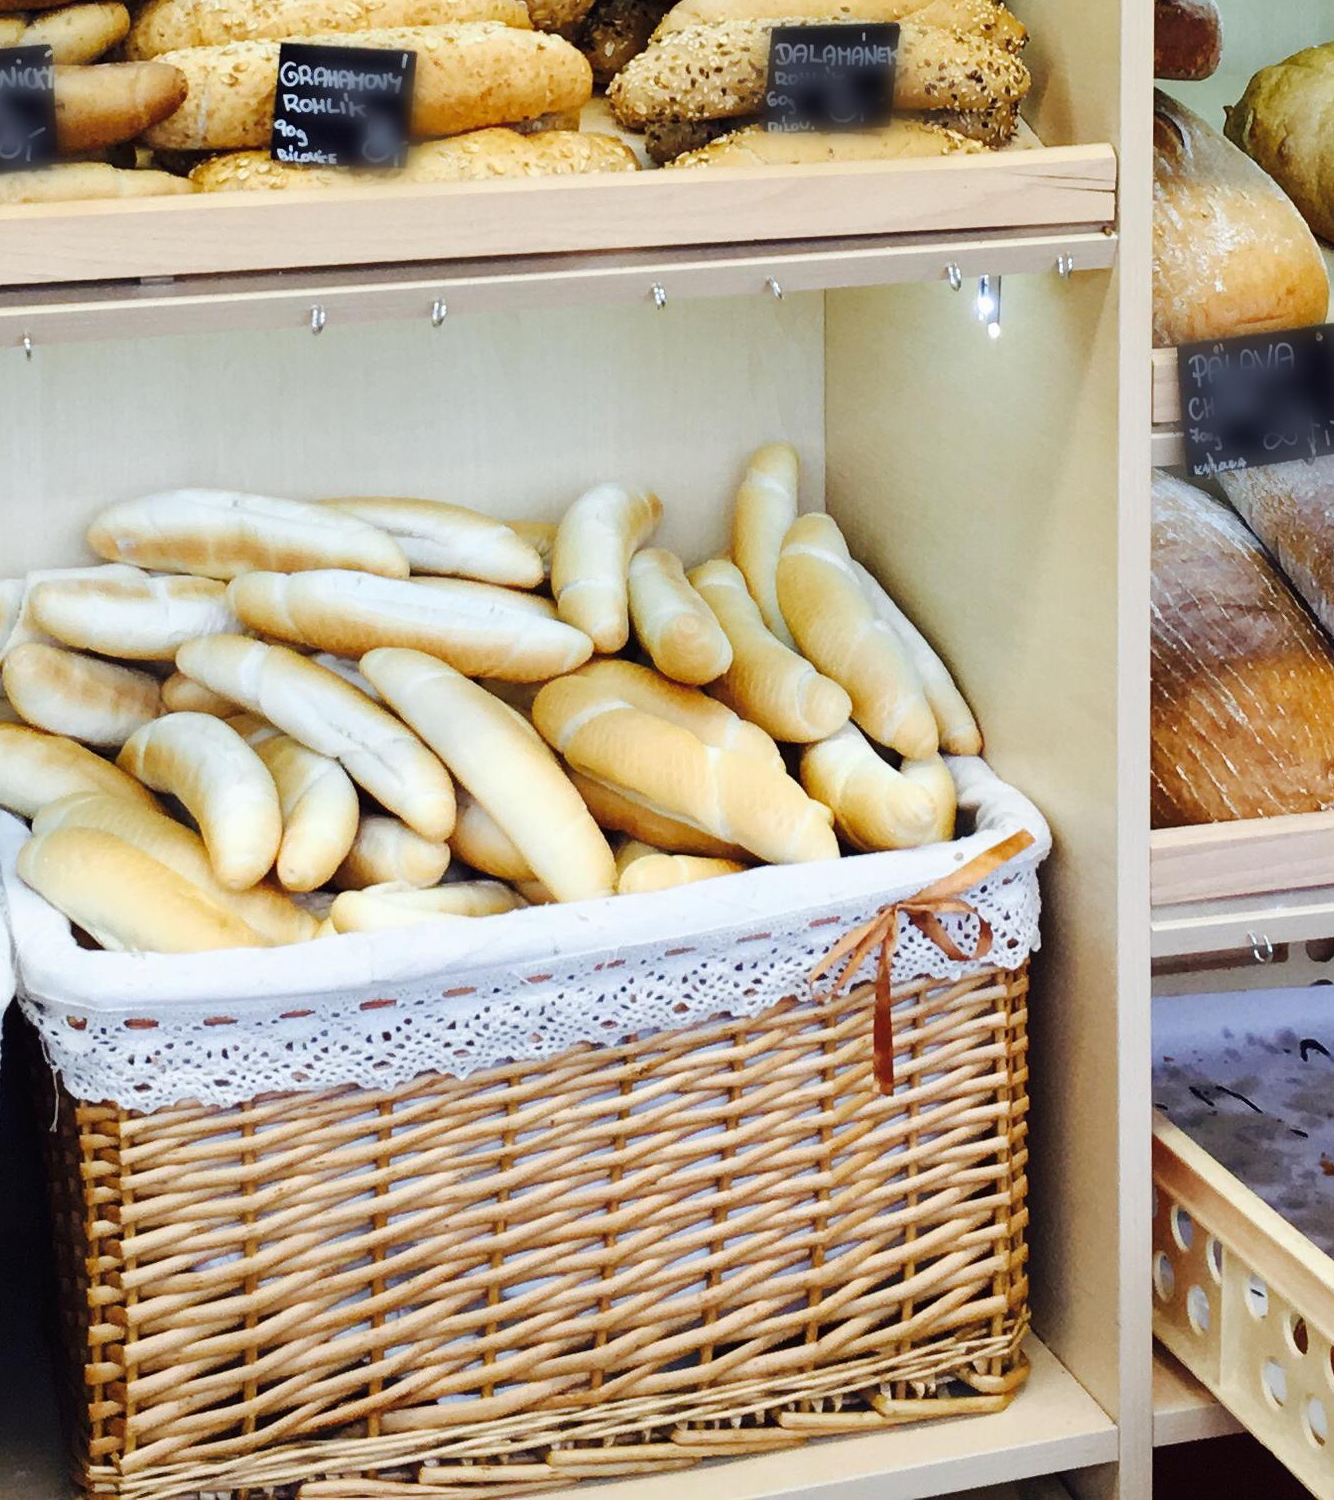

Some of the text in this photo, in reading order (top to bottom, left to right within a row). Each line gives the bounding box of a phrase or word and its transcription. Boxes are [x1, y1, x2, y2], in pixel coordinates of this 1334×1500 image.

[774, 32, 900, 68] DALAMÁNEK
[279, 53, 409, 95] GRAHAMOVÝ
[282, 92, 367, 118] ROHLÍK
